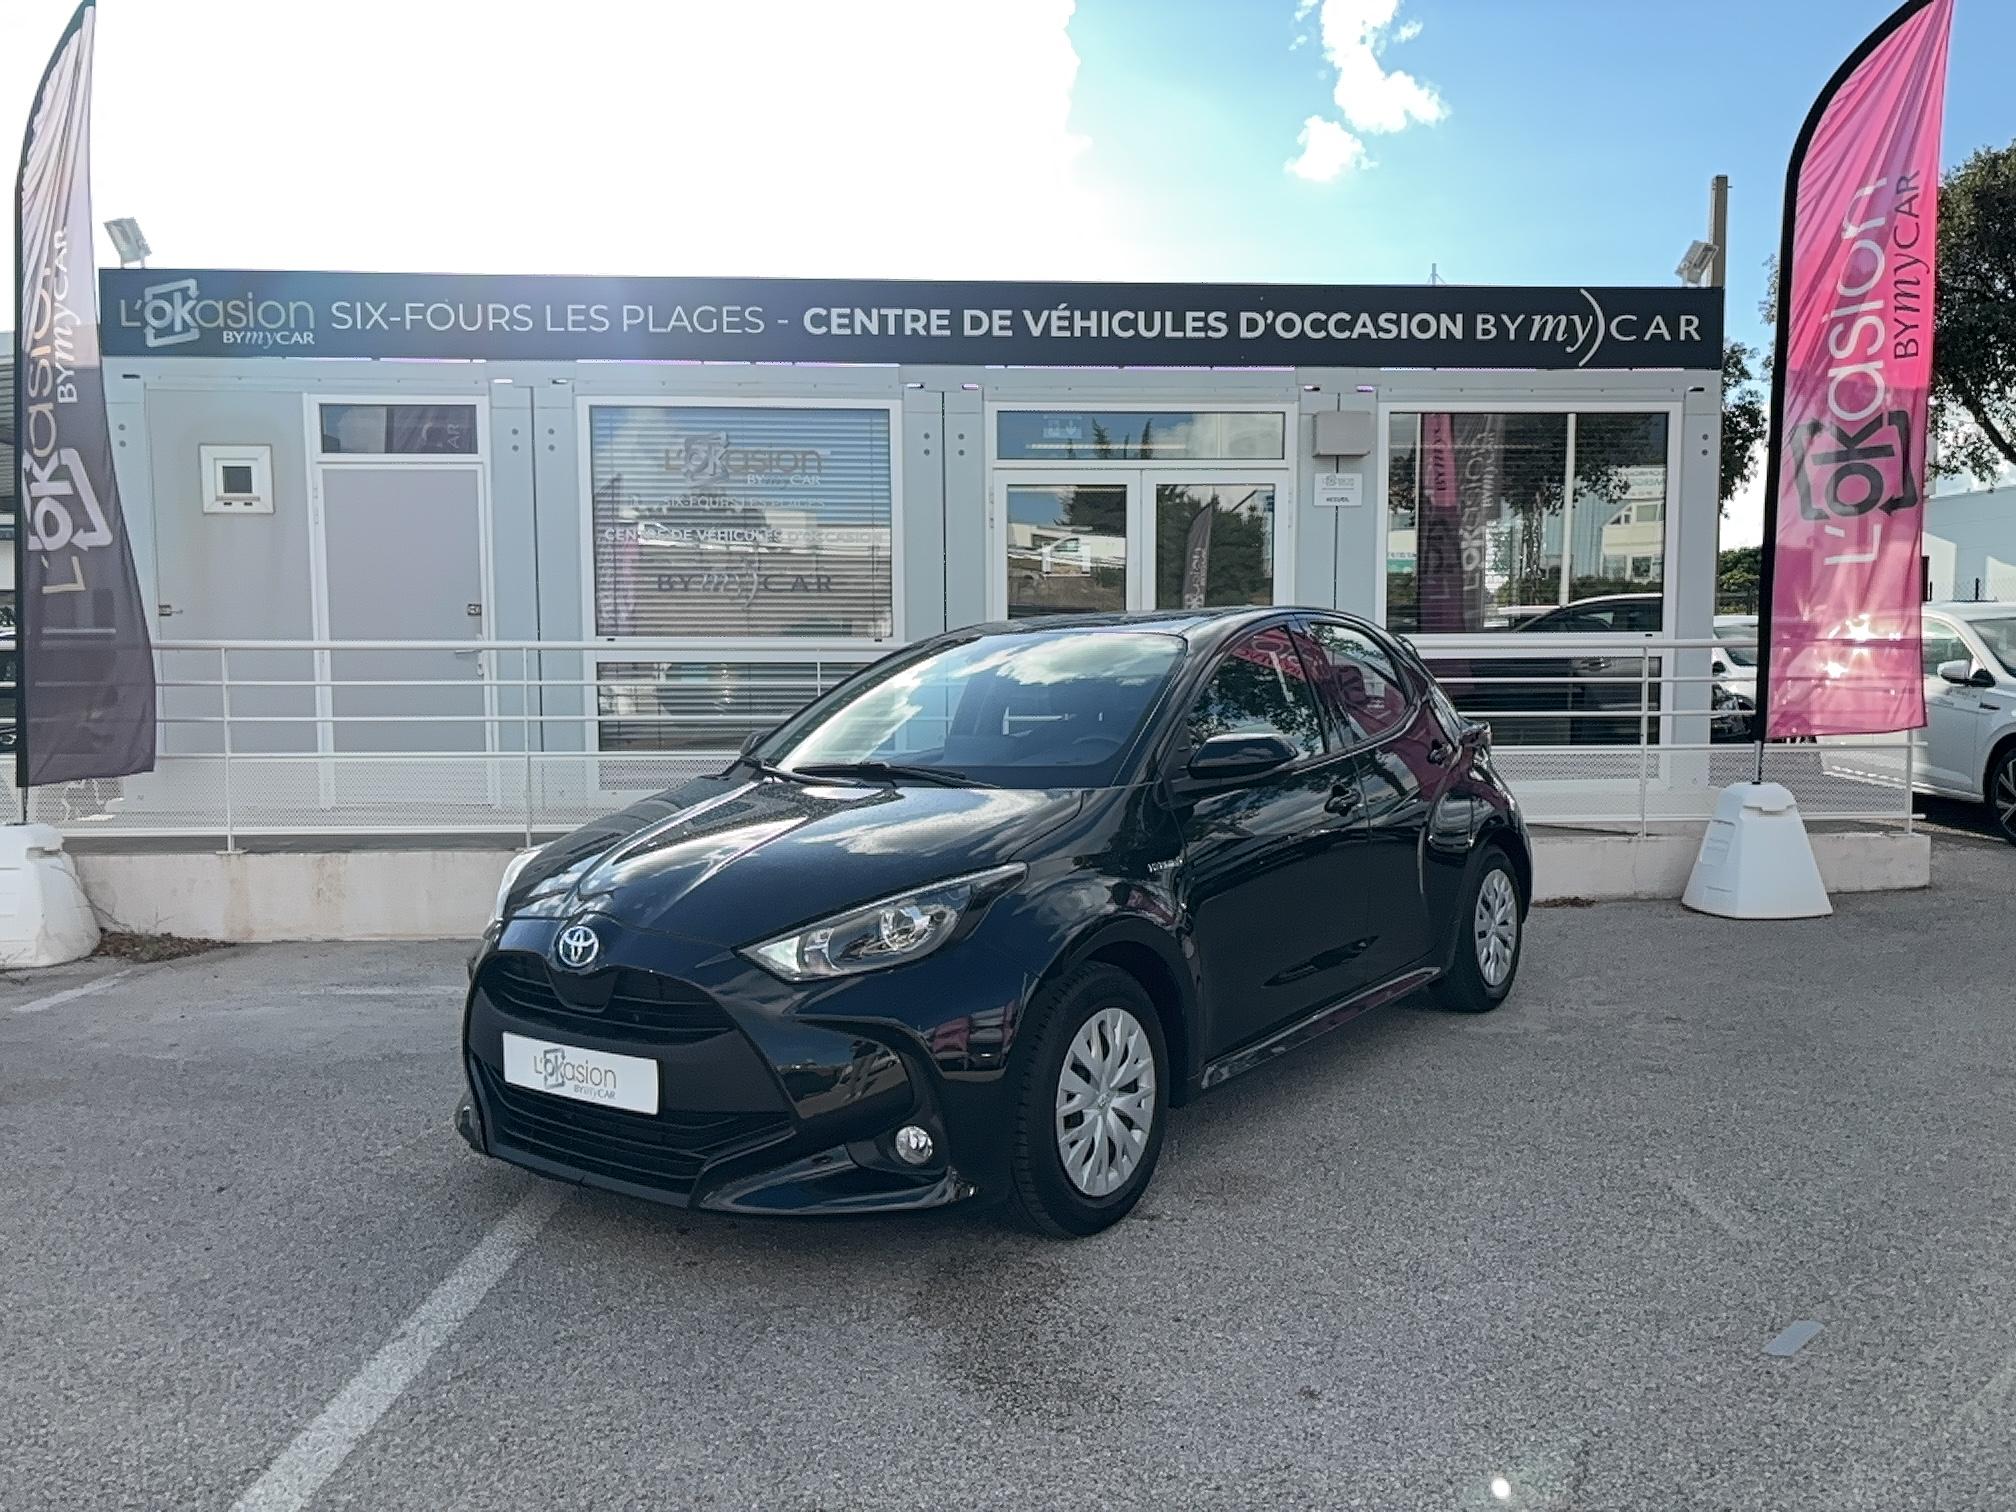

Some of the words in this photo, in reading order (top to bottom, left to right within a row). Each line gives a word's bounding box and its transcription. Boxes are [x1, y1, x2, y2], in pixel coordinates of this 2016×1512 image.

[330, 300, 534, 333] SIX-FOURS
[545, 304, 609, 334] LES
[623, 304, 766, 335] PLAGES
[803, 307, 952, 337] CENTRE
[963, 309, 1013, 338] DE
[1022, 303, 1229, 340] VÉHICULES
[1239, 310, 1464, 340] D'OCCASION
